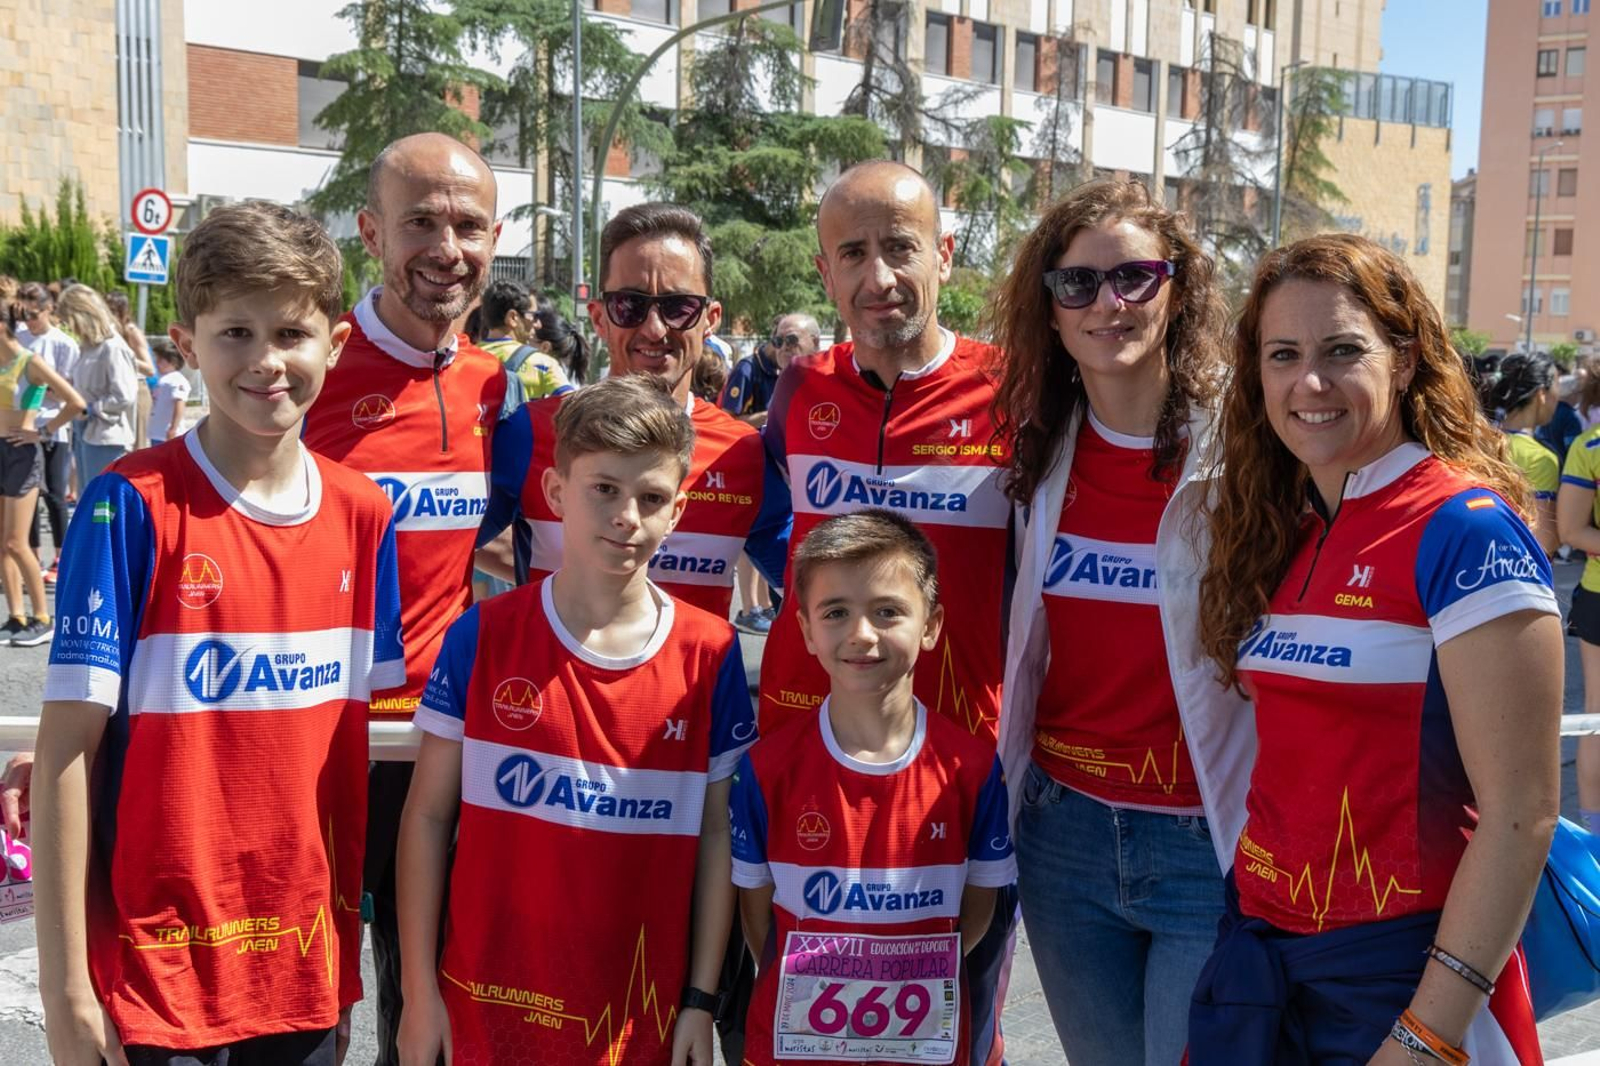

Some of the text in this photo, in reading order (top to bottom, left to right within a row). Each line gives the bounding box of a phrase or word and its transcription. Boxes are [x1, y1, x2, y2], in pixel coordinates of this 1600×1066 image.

[912, 445, 1003, 456] SERGIO ISMAEL
[413, 488, 488, 517] Avanz
[435, 488, 459, 497] GRUPO
[718, 493, 752, 504] REYES
[842, 475, 968, 512] Avanza
[649, 553, 727, 575] vanza
[1101, 554, 1132, 564] GRUPO
[1069, 553, 1157, 589] Avan
[1335, 593, 1373, 608] GEMA
[1277, 632, 1297, 640] GRUPO
[275, 653, 306, 665] GRUPO
[1249, 631, 1352, 667] Avanza
[244, 654, 341, 692] Avanza
[576, 778, 606, 792] GRUPO
[544, 775, 673, 820] Avanza
[1246, 861, 1277, 882] JAEN
[843, 883, 943, 911] Avanza
[867, 883, 891, 892] GRUPO
[155, 917, 280, 942] TRAILRUNNERS
[237, 938, 278, 955] JAEN
[795, 936, 865, 957] XXVII
[795, 954, 949, 980] CARRERA POPULAR
[524, 1011, 562, 1029] JAEN
[808, 983, 932, 1037] 669
